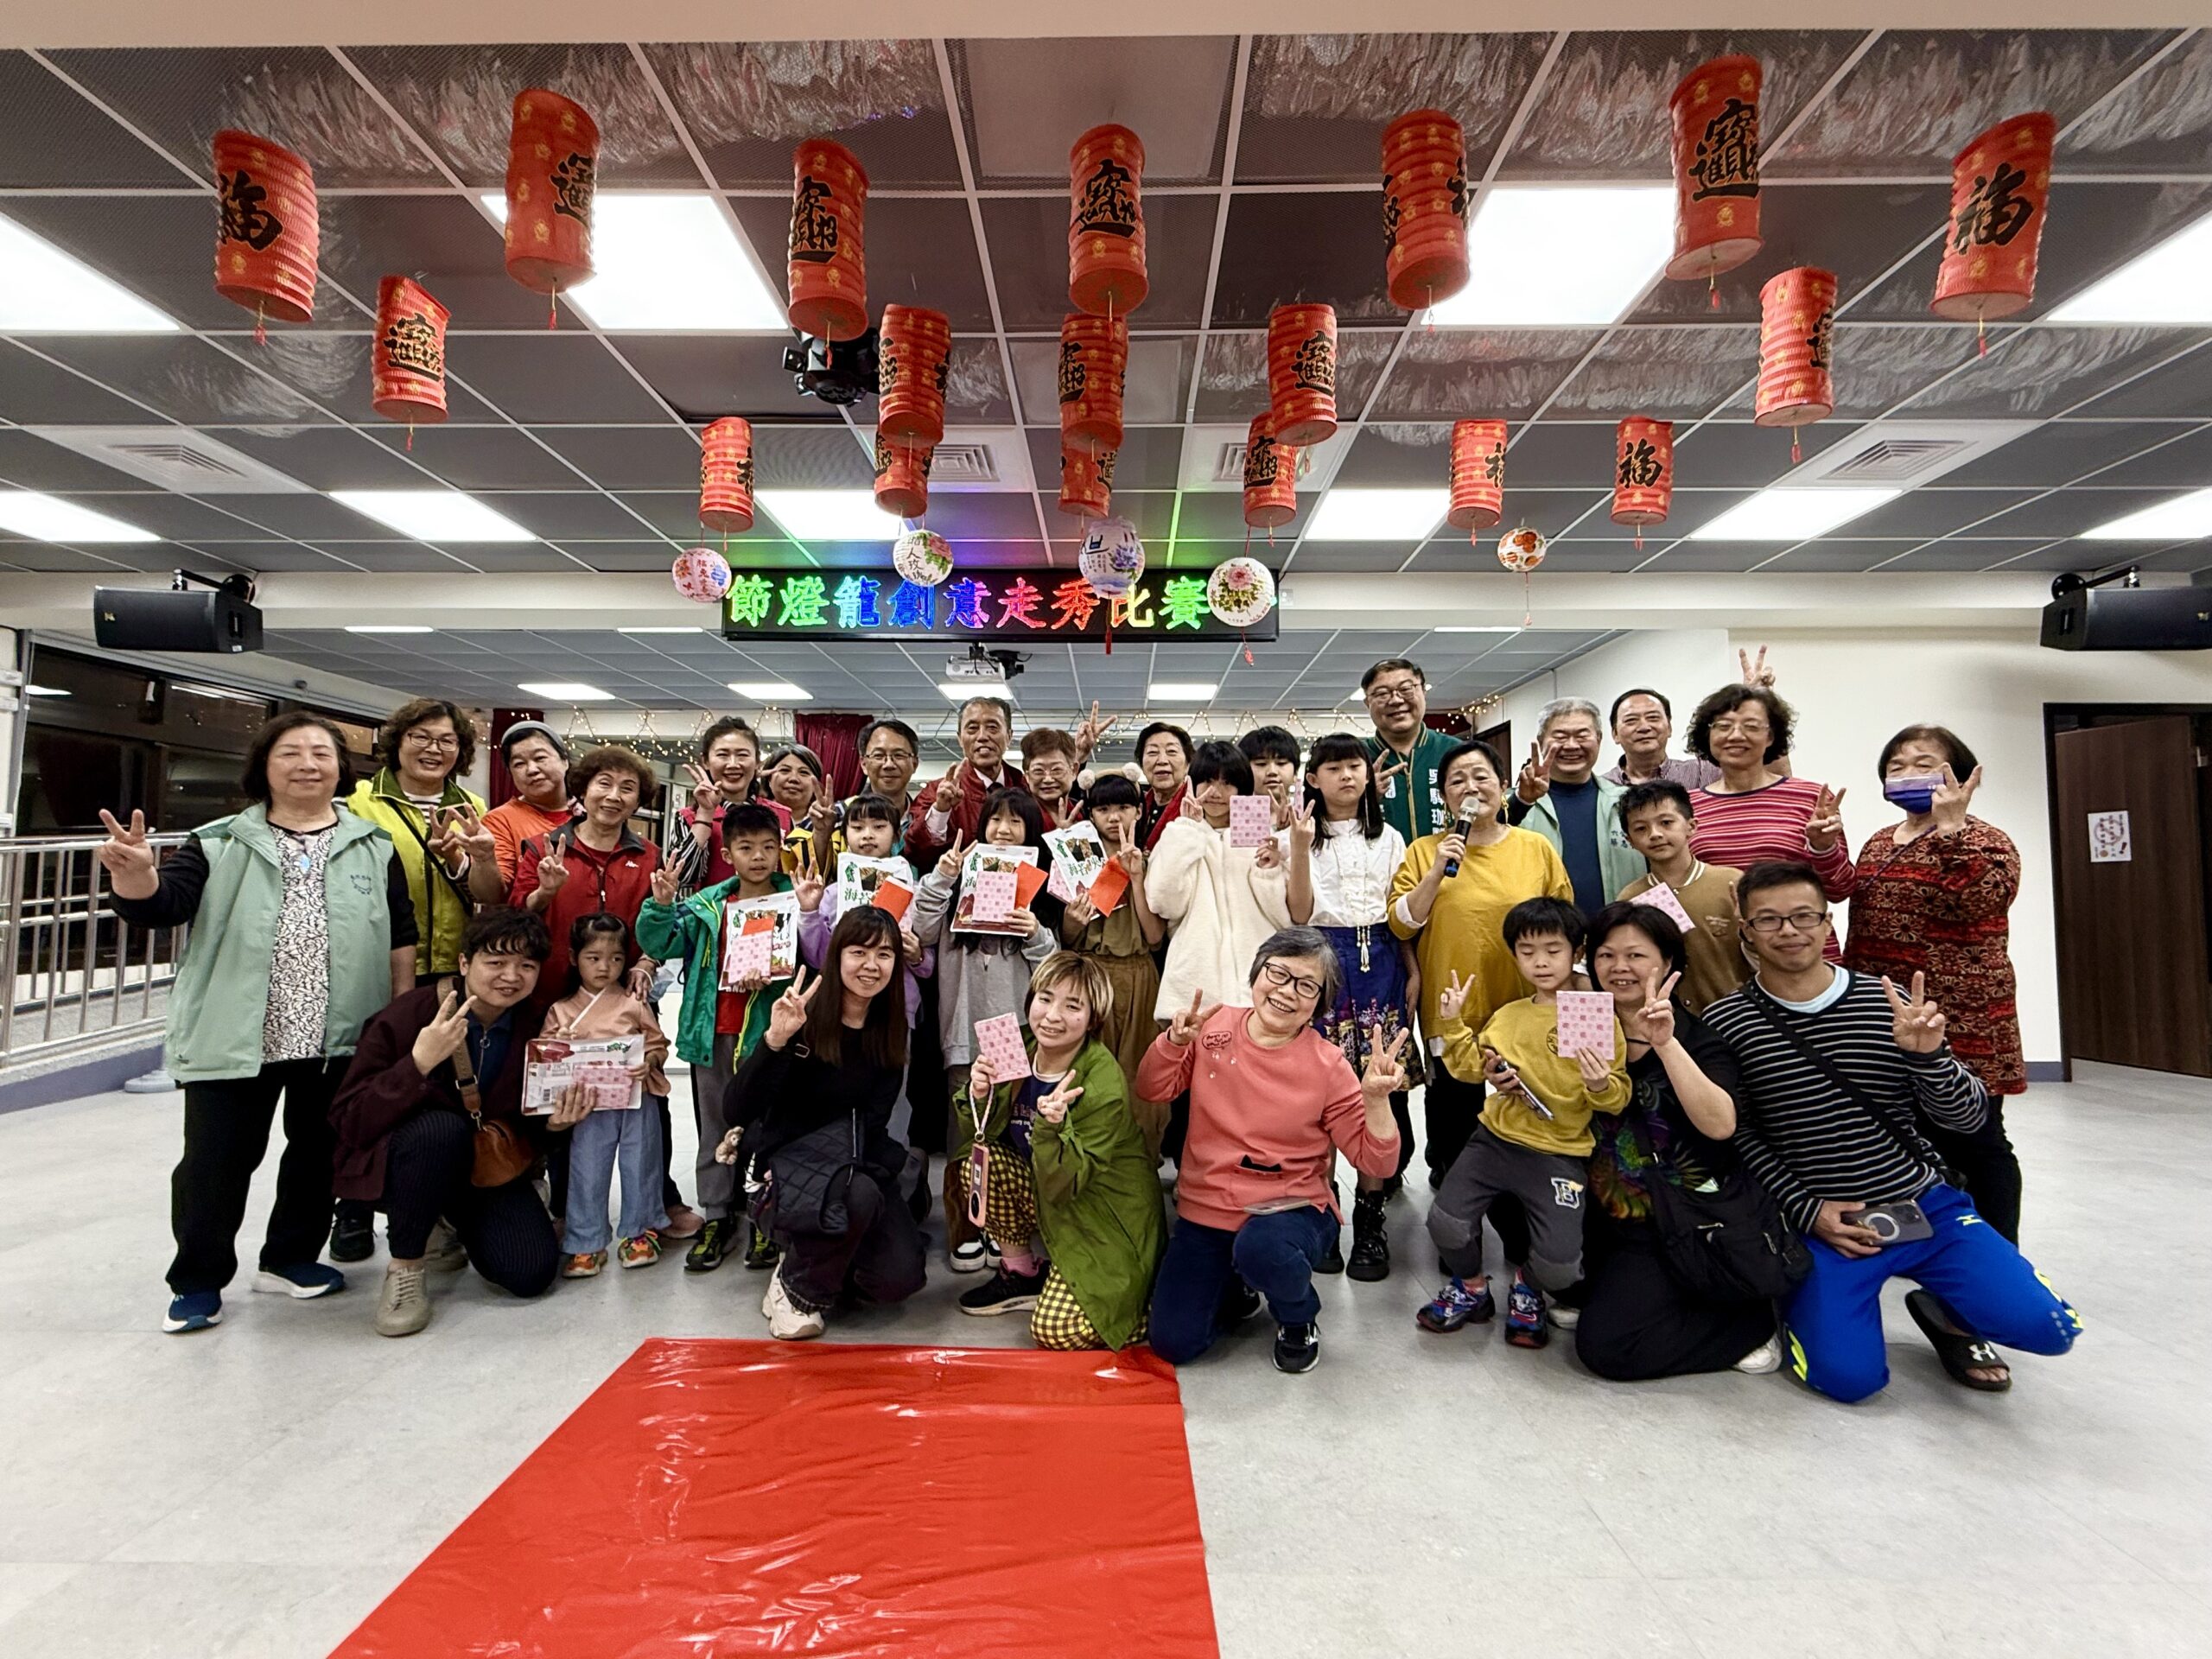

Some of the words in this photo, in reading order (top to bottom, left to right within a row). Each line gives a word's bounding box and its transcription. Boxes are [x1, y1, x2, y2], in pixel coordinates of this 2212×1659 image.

[219, 170, 283, 251] 福
[1954, 162, 2034, 256] 福
[1619, 439, 1662, 489] 福
[726, 574, 1210, 630] 節燈籠創意走秀比賽
